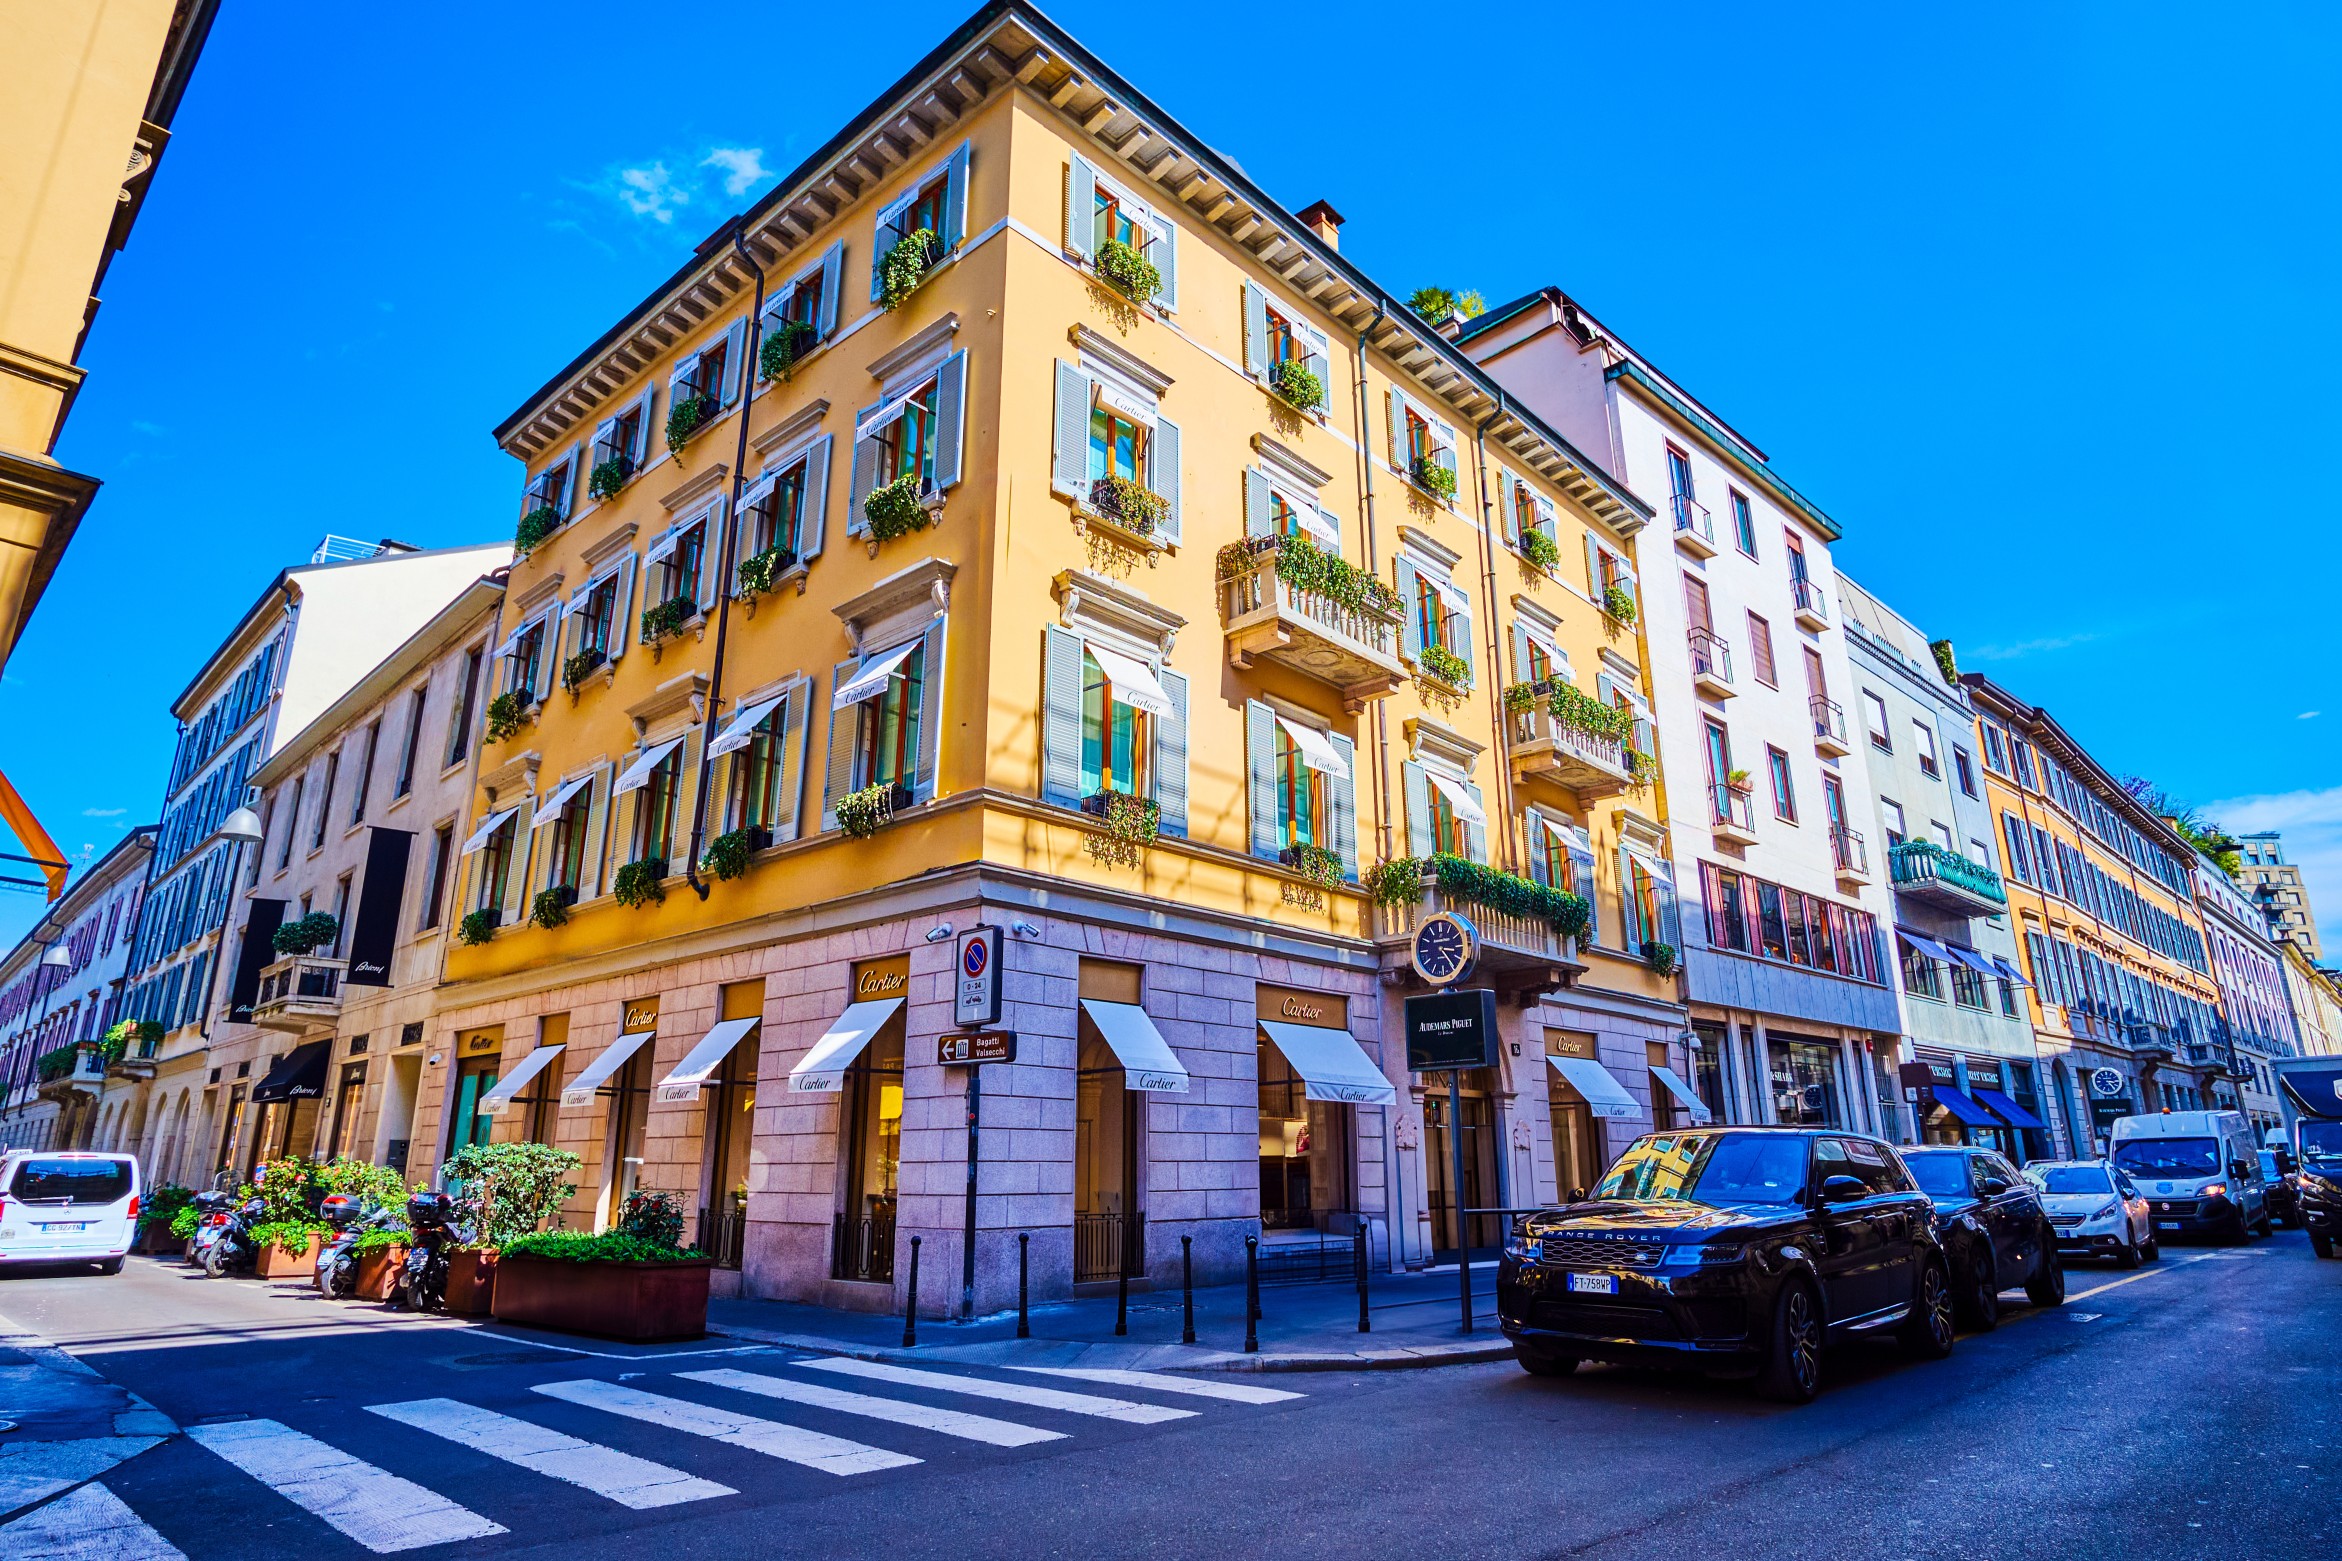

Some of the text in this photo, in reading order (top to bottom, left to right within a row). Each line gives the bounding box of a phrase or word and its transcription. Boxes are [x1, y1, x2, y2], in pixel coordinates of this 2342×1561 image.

[883, 198, 910, 222] Cartier
[1129, 210, 1157, 233] Cartier
[765, 291, 788, 312] Cartier
[1298, 332, 1322, 352] Cartier
[1114, 397, 1148, 420] Cartier
[866, 411, 894, 434] Cartier
[743, 489, 765, 509] Cartier
[1305, 520, 1330, 538] Cartier
[845, 684, 874, 704] Cartier
[1128, 691, 1160, 711] Cartier
[717, 739, 740, 754] Cartier
[1315, 757, 1339, 773] Cartier
[620, 779, 640, 791] Cartier
[1462, 809, 1480, 822] Cartier
[356, 962, 384, 974] Brioni
[859, 970, 906, 995] Cartier
[1281, 997, 1323, 1020] Cartier
[626, 1008, 657, 1027] Cartier
[1419, 1019, 1472, 1031] AUDEMARS PIGUET
[470, 1035, 492, 1050] Cartier
[977, 1037, 999, 1046] Bagatti
[1557, 1036, 1581, 1053] Cartier
[977, 1048, 1004, 1056] Valsecchi
[289, 1085, 316, 1095] Brioni
[800, 1074, 831, 1091] Cartier
[1140, 1073, 1176, 1090] Cartier
[567, 1093, 587, 1105] Cartier
[665, 1087, 690, 1100] Cartier
[1341, 1087, 1367, 1102] Cartier
[485, 1103, 501, 1113] Cartier
[1548, 1231, 1661, 1241] RANGE ROVER
